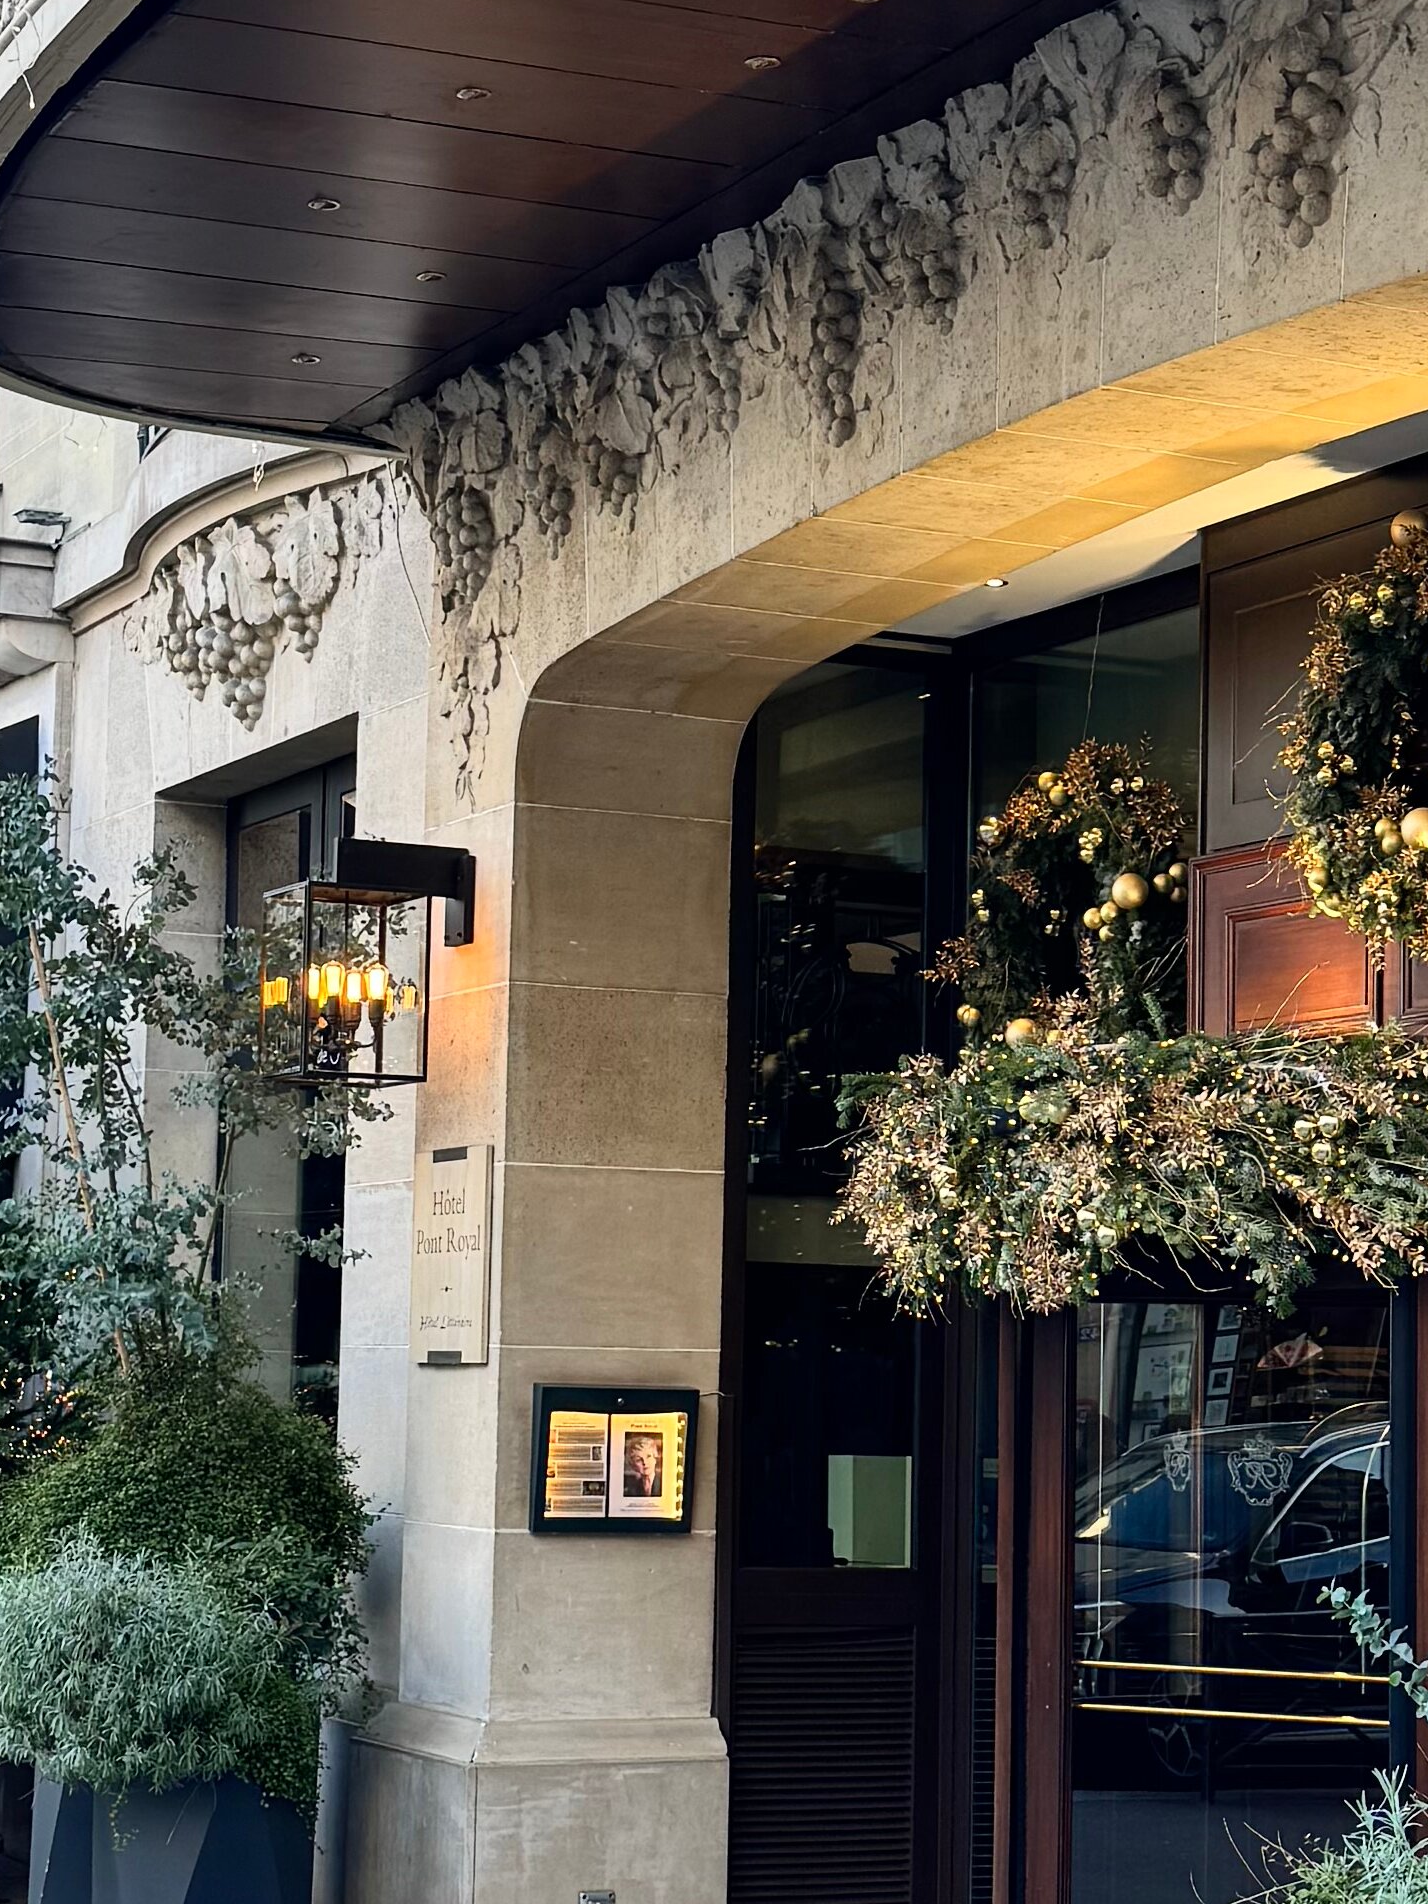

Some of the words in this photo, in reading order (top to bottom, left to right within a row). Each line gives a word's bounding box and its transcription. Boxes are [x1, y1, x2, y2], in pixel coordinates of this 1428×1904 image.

[432, 1188, 466, 1216] Hôtel
[416, 1229, 442, 1255] Pont
[446, 1224, 481, 1260] Royal
